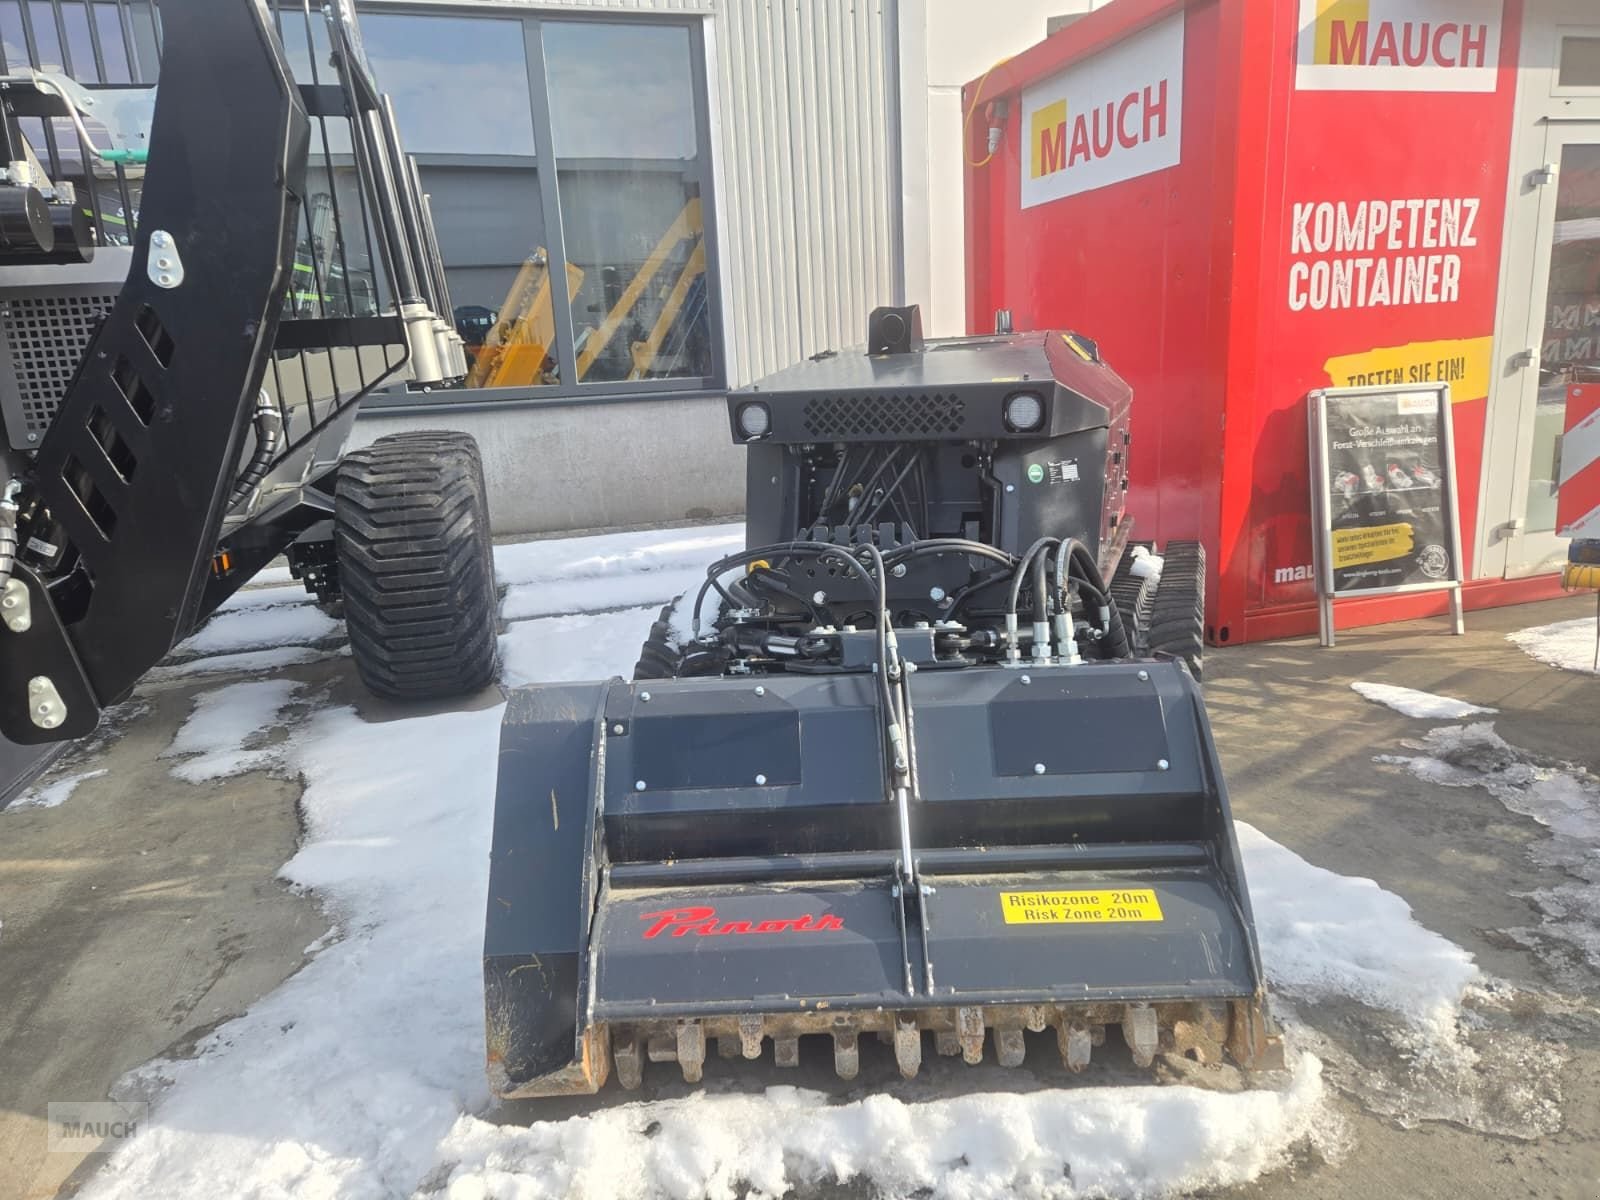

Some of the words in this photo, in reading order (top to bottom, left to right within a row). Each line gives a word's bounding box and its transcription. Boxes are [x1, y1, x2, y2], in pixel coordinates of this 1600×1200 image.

[1328, 20, 1487, 69] MAUCH
[1040, 79, 1167, 177] MAUCH
[1291, 198, 1480, 254] KOMPETENZ
[1288, 254, 1461, 311] CONTAINER
[1437, 357, 1465, 382] EIN!
[1009, 894, 1100, 907] Risikozone
[1111, 892, 1149, 905] 20m
[1024, 908, 1059, 920] Risk
[1065, 907, 1102, 919] Zone
[1107, 907, 1143, 919] 20m
[640, 906, 844, 939] Prinoth
